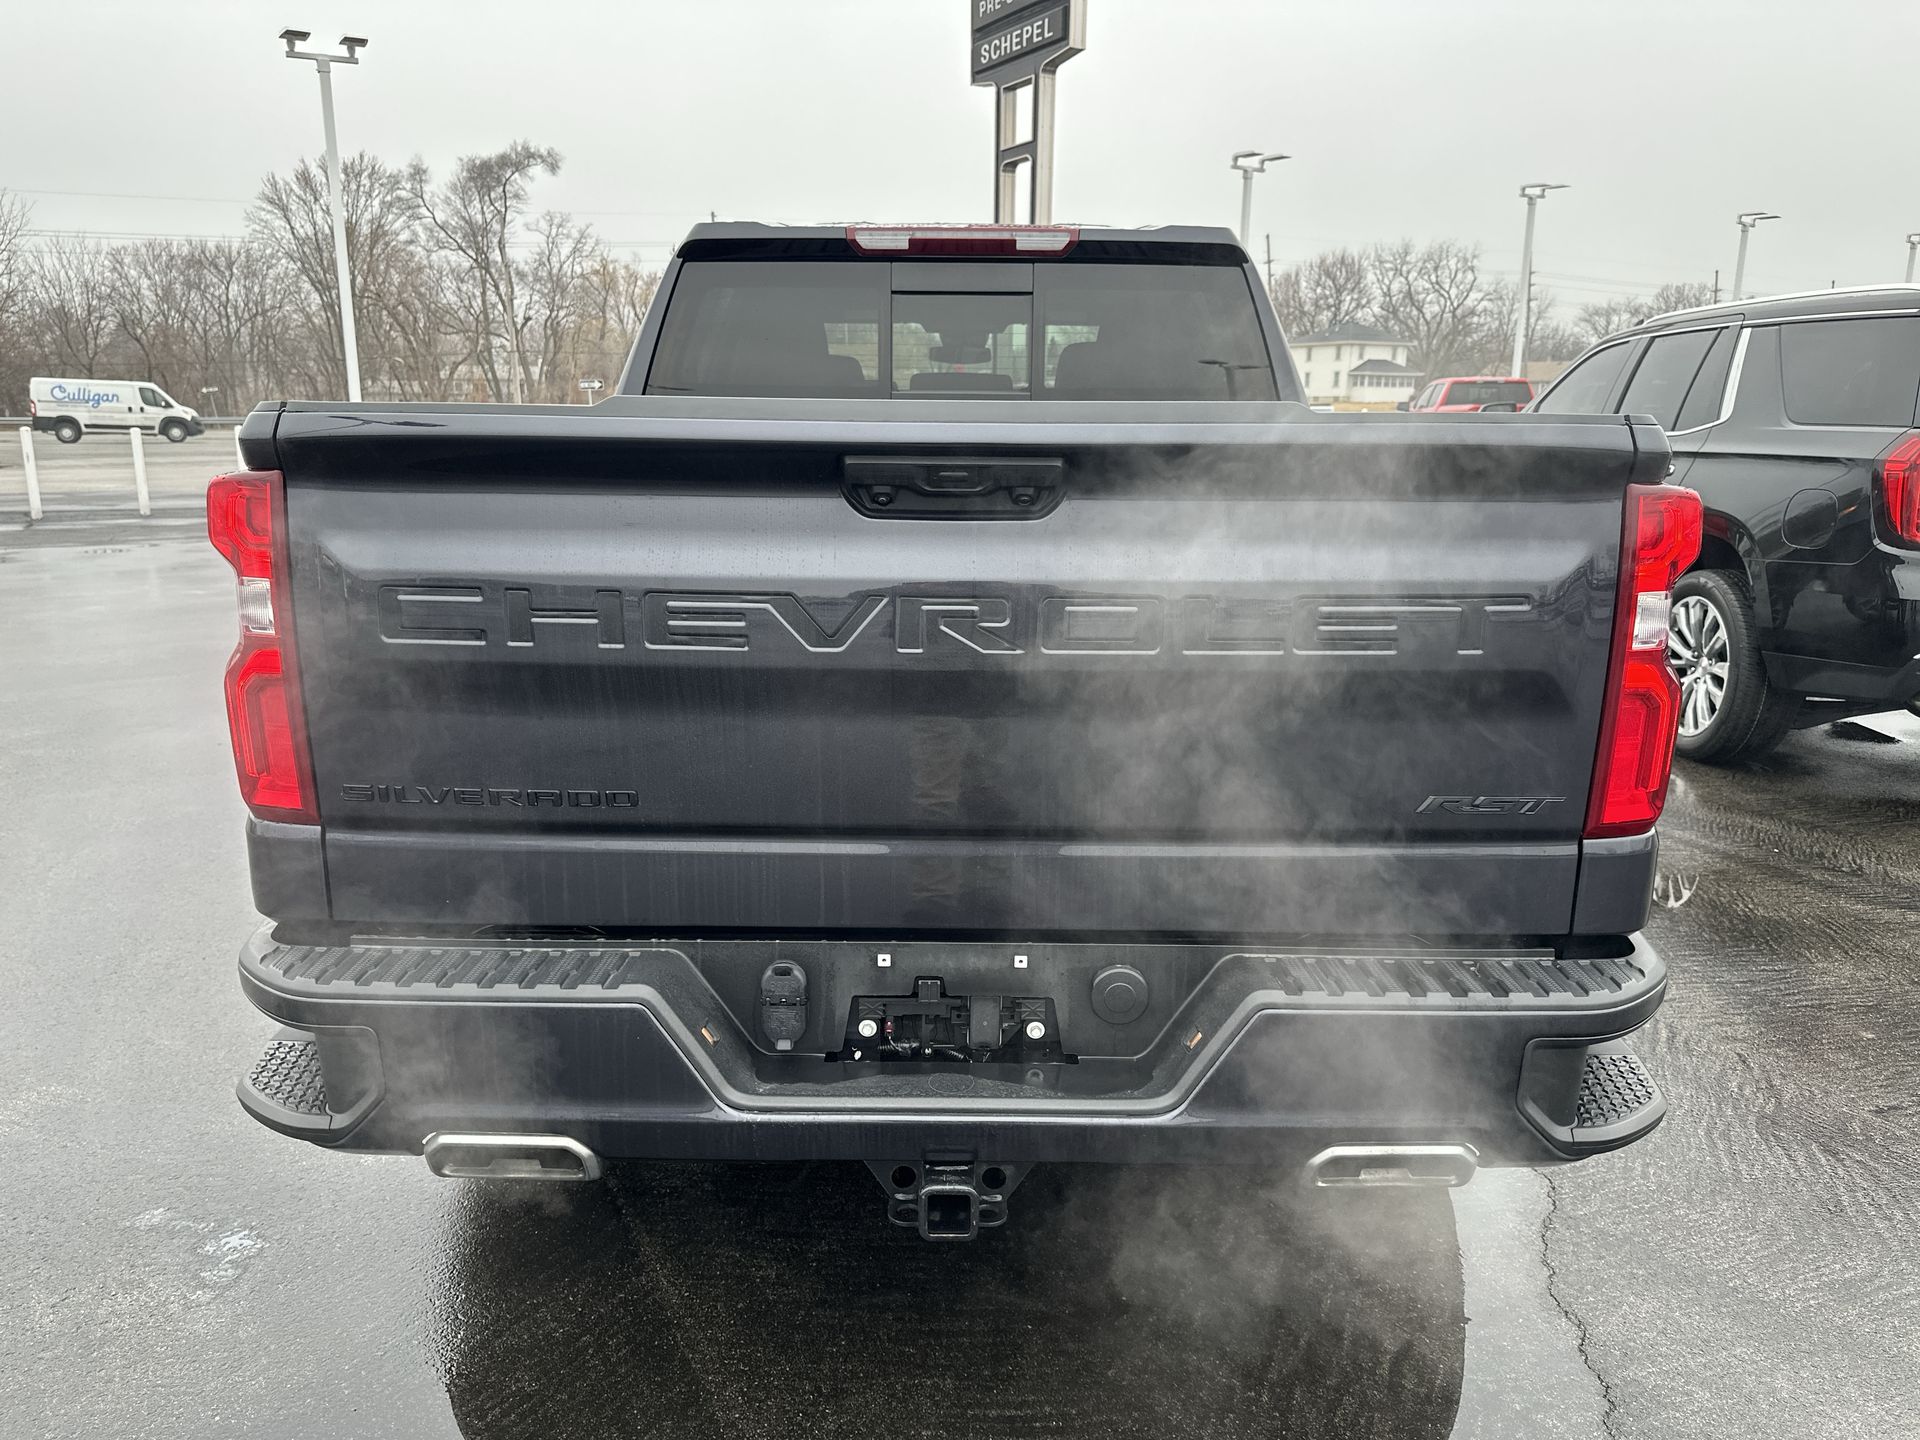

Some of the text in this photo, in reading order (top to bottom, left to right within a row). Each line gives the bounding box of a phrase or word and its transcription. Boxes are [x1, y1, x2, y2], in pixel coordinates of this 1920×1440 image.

[981, 18, 1053, 64] SCHEPEL
[51, 384, 119, 408] Culligan
[378, 585, 1532, 655] CHEVROLET
[342, 784, 640, 808] SILVERADO
[1415, 795, 1567, 815] RST
